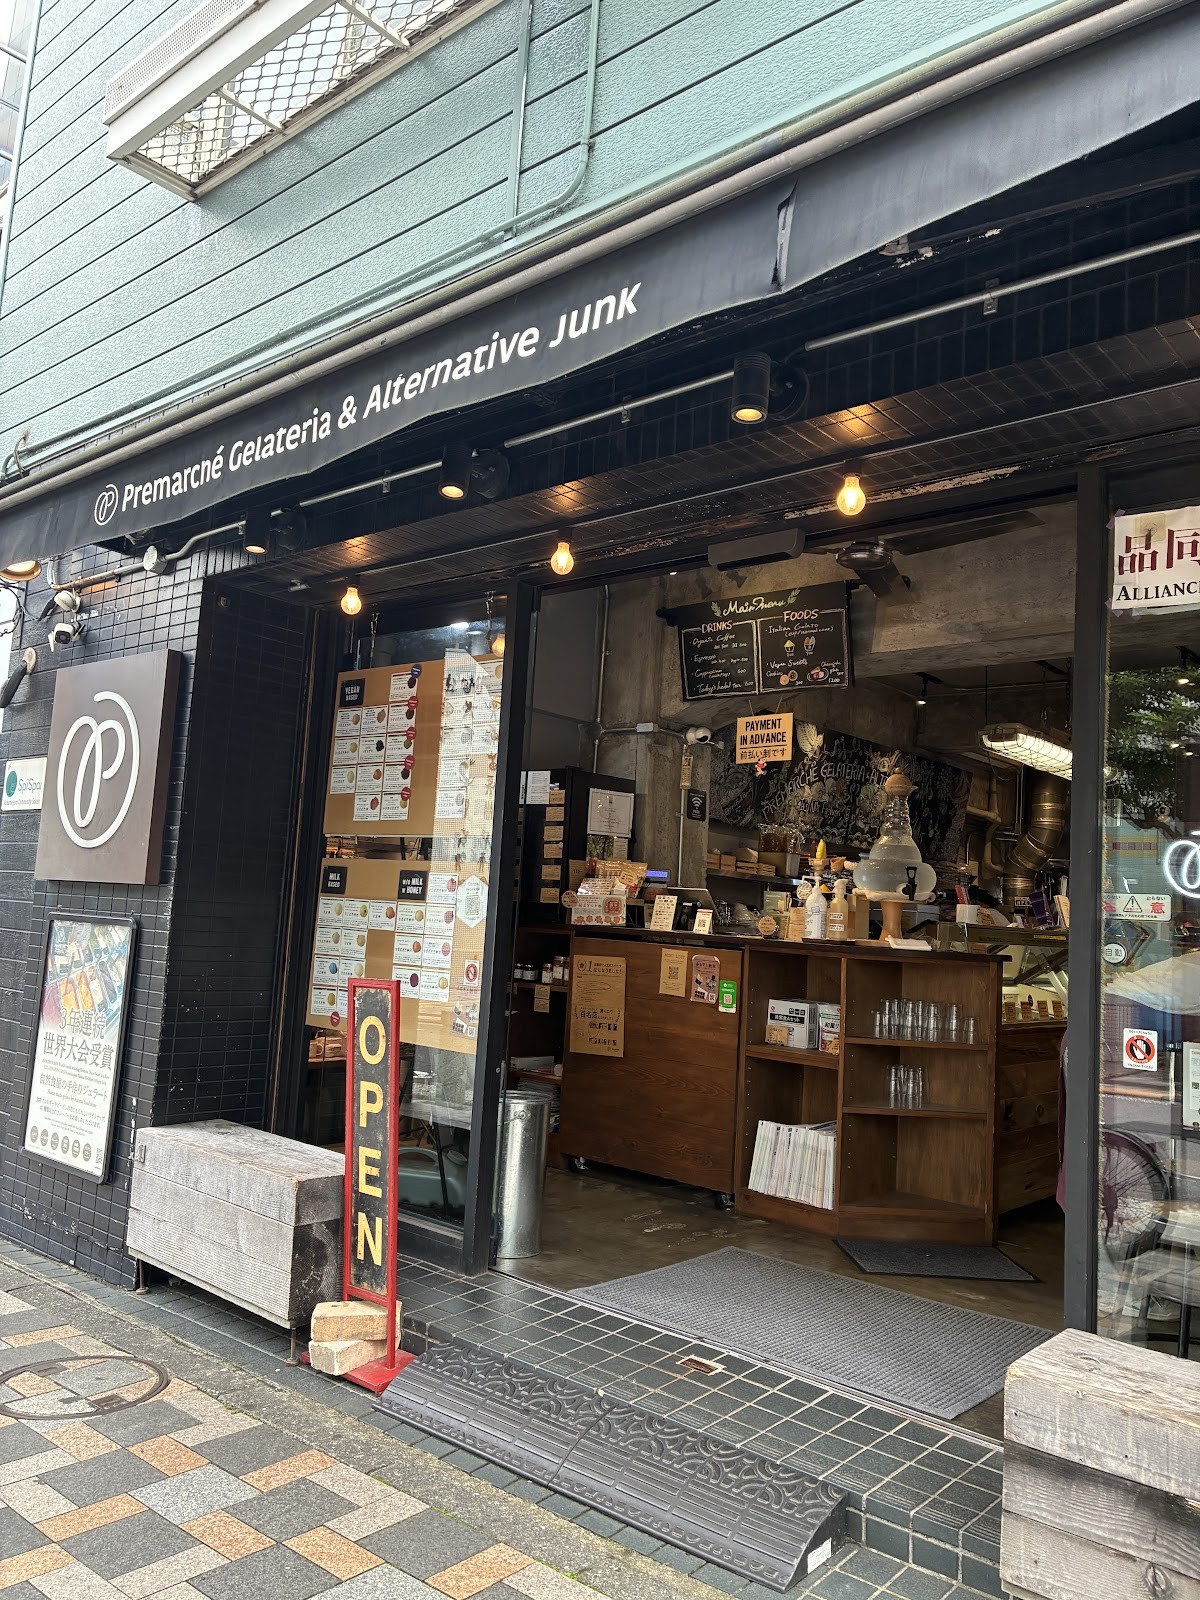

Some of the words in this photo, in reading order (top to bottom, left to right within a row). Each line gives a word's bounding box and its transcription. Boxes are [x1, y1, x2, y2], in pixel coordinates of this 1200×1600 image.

[228, 407, 331, 472] Gelateria
[337, 395, 357, 429] &
[362, 325, 540, 420] Alternative
[722, 600, 754, 617] Main
[783, 609, 819, 622] FOODS
[701, 620, 732, 634] DRINKS
[345, 685, 360, 694] VEGAN
[745, 718, 782, 732] PAYMENT
[740, 735, 747, 746] IN
[749, 731, 787, 745] ADVANCE
[329, 872, 341, 881] MILK
[411, 877, 424, 886] MILK
[406, 886, 423, 895] HONEY
[59, 1007, 107, 1040] 3年連続
[43, 1031, 115, 1071] 世界大会受賞
[355, 1014, 387, 1268] OPEN
